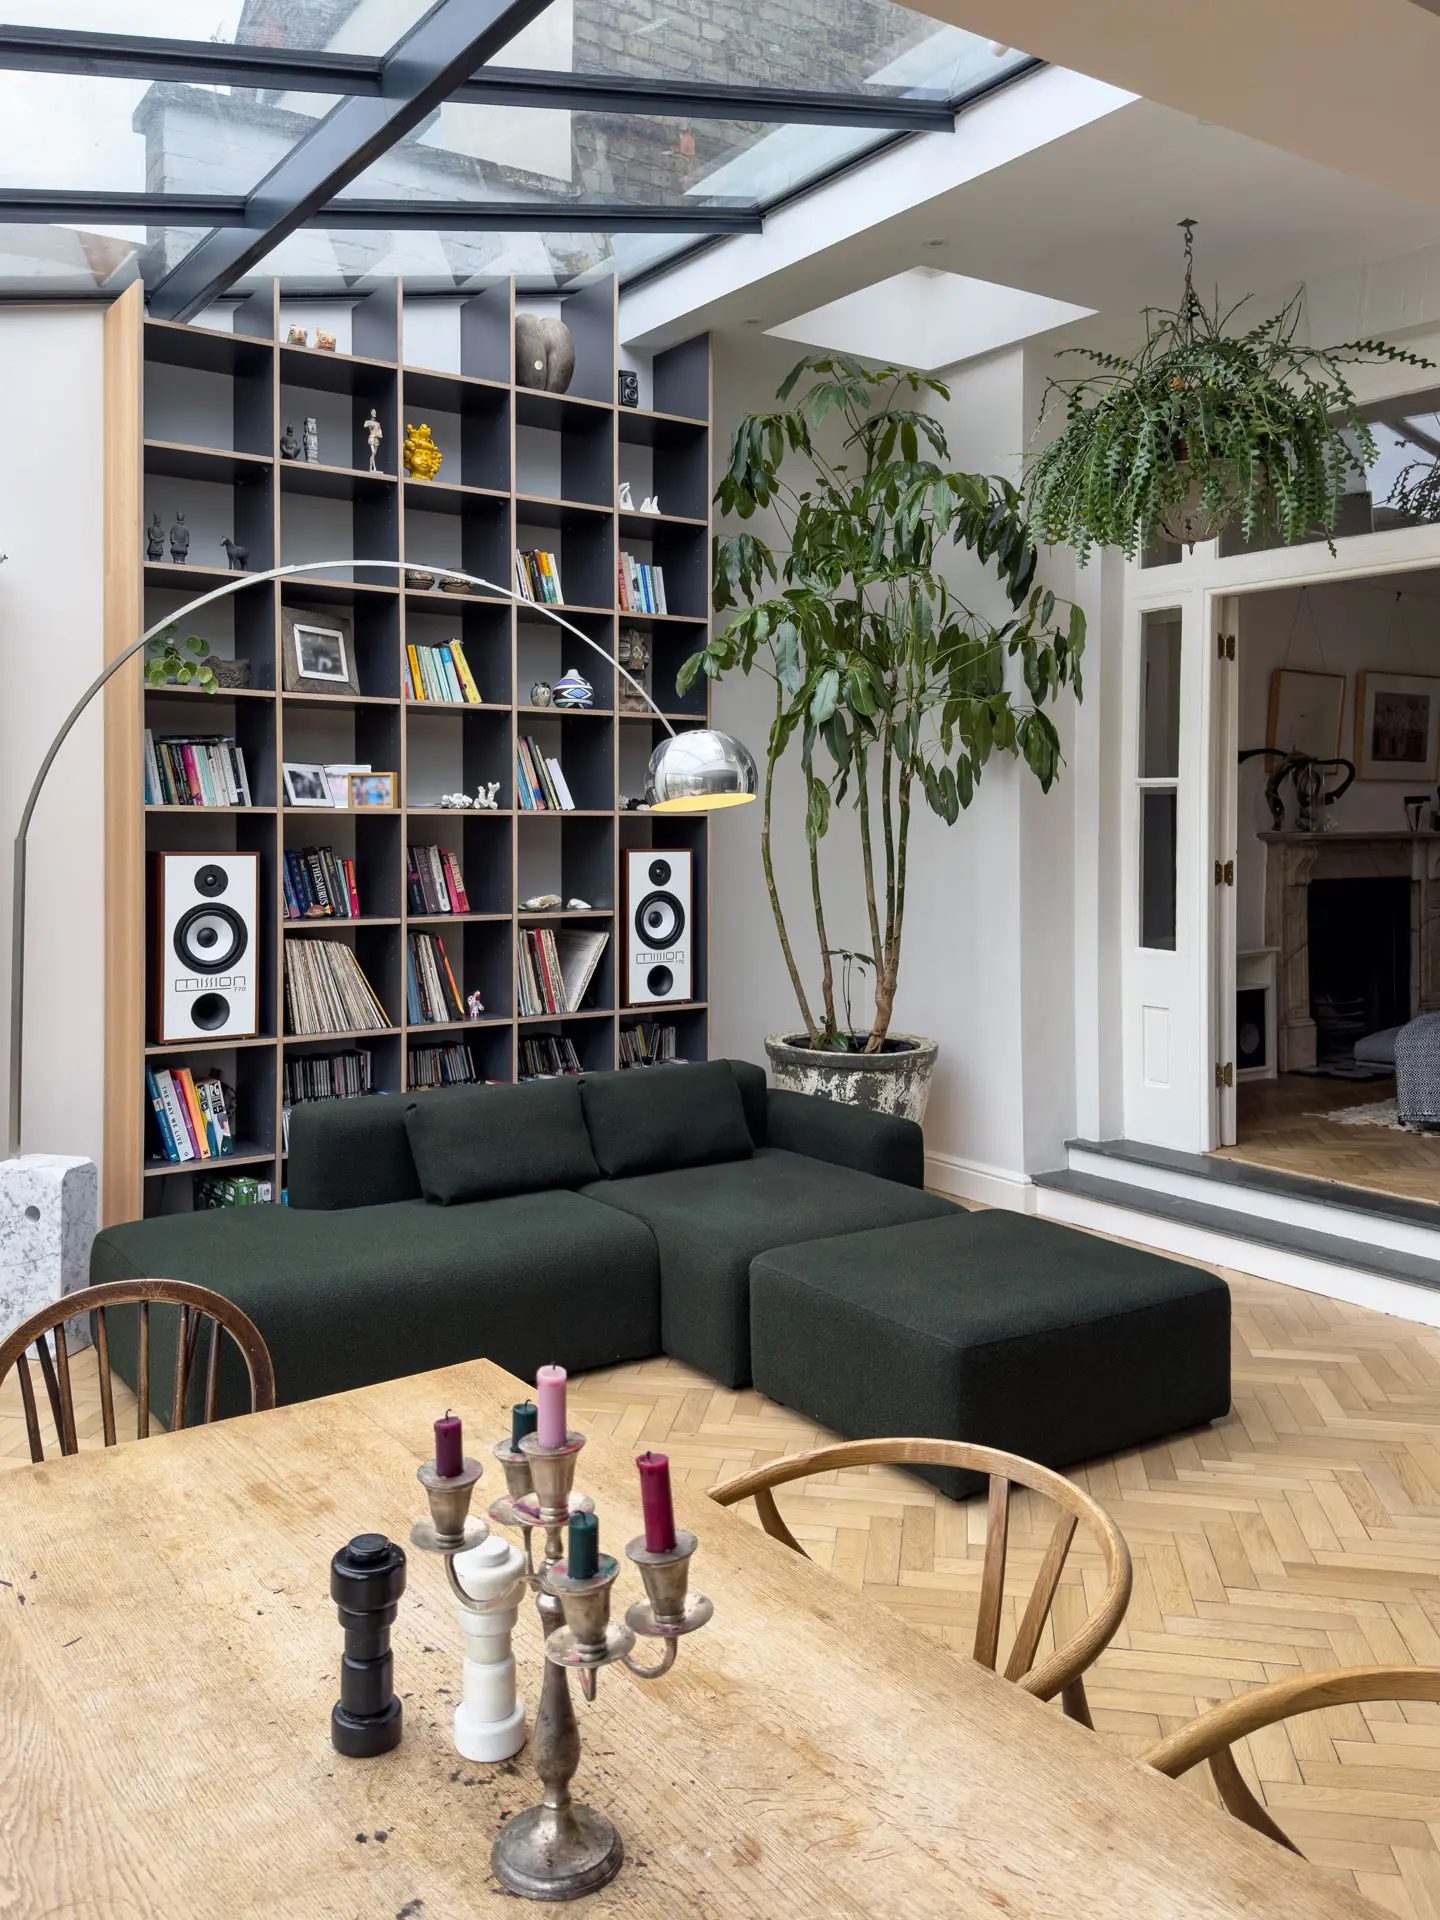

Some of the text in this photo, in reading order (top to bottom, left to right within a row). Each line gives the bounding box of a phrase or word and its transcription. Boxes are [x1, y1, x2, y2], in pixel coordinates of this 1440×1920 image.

[311, 861, 329, 906] THESAURUS
[209, 1083, 220, 1097] PG
[161, 1085, 183, 1146] THE WAY WE LIVE
